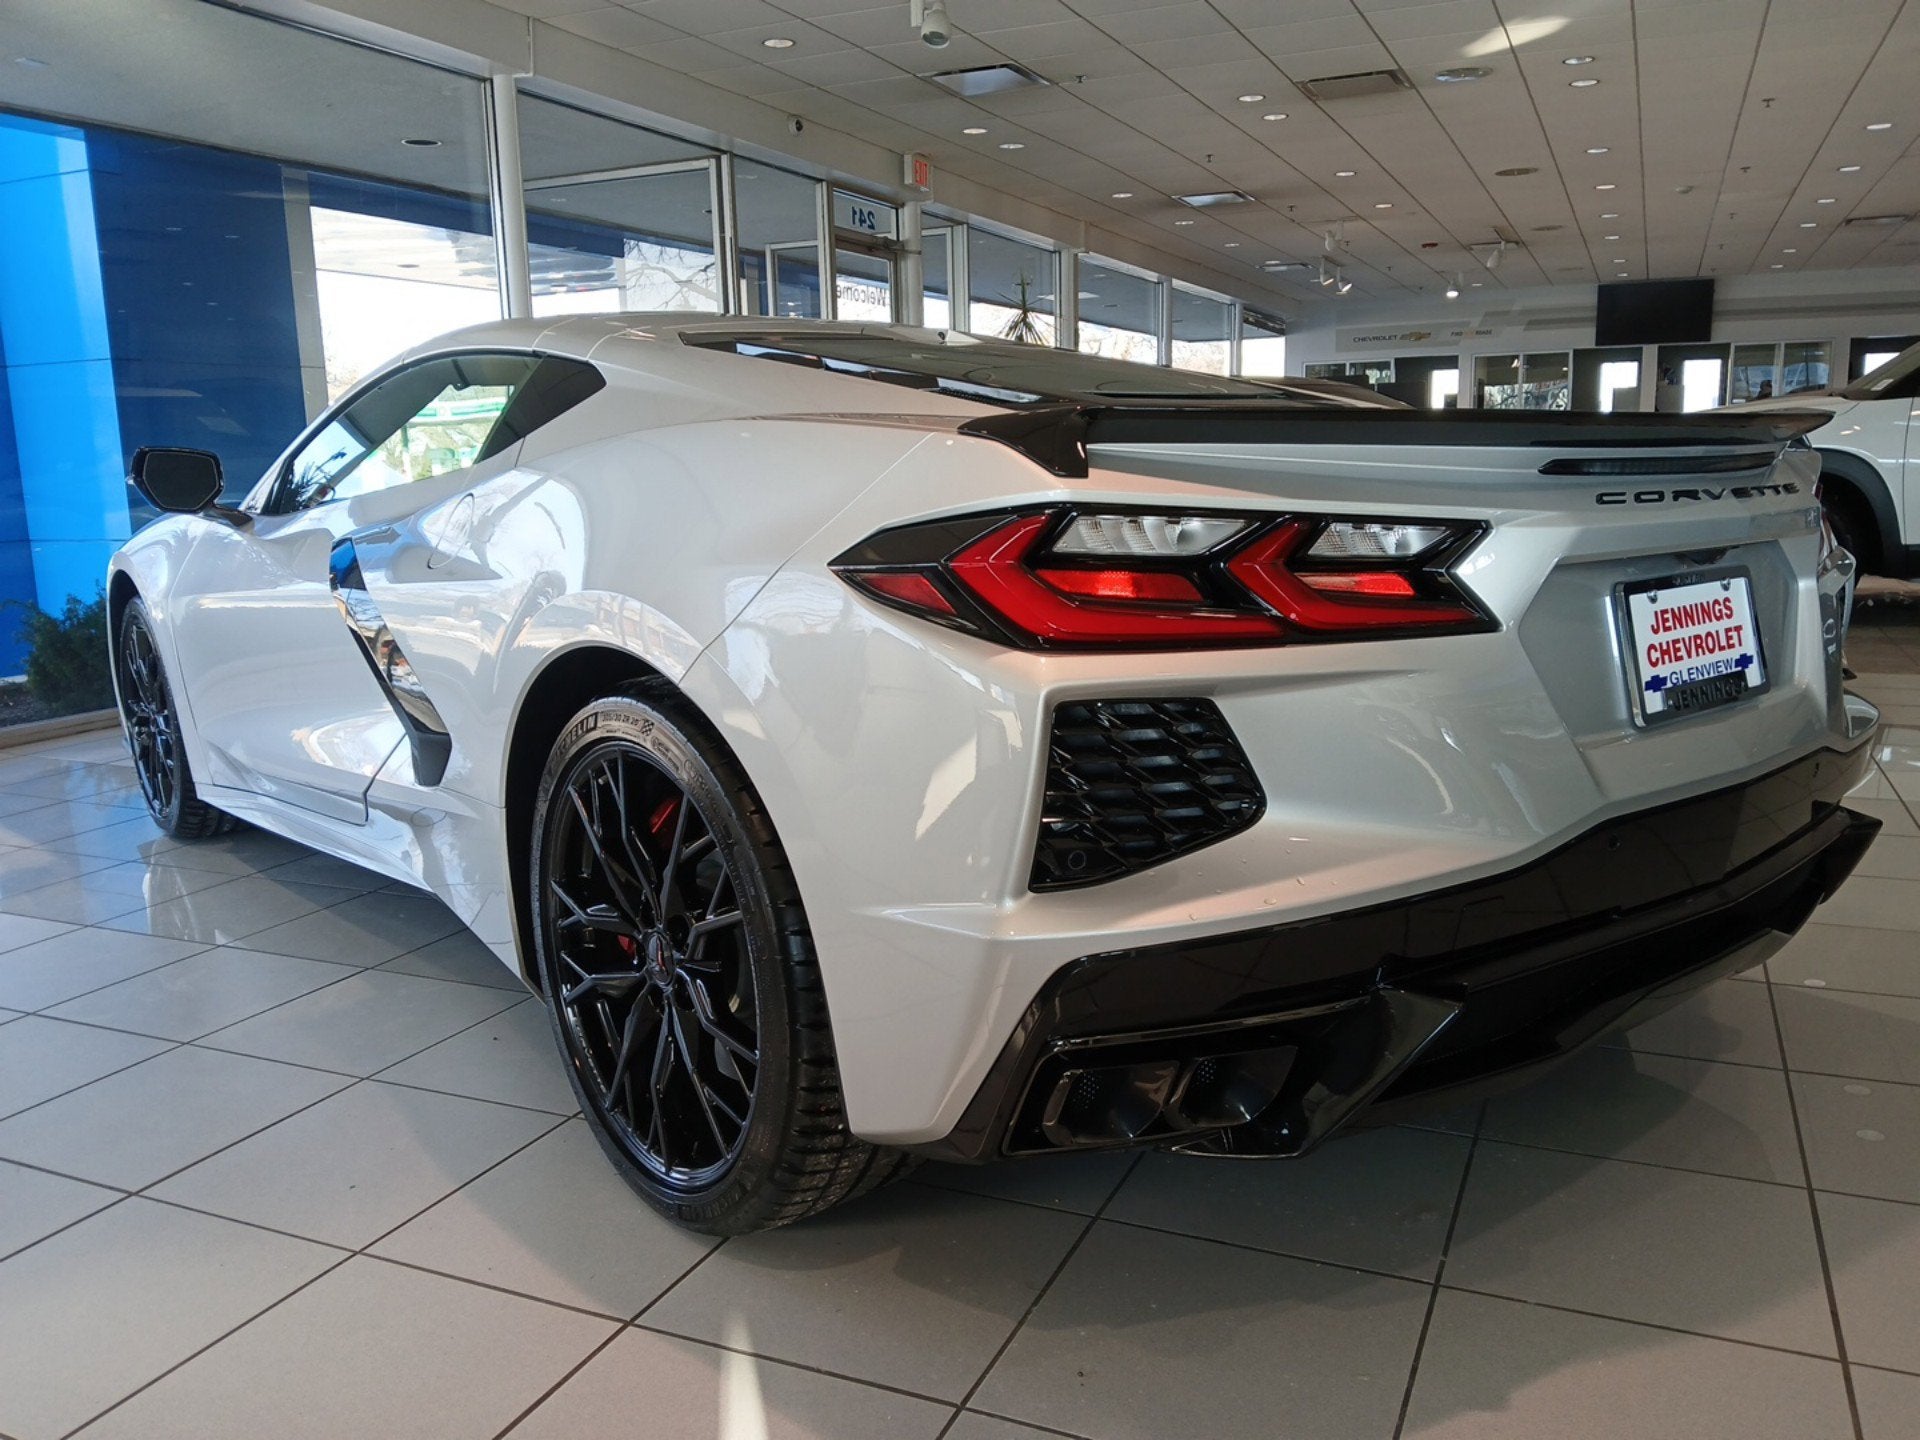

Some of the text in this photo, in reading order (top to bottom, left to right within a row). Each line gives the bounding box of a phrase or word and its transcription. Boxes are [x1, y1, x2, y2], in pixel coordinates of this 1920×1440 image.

[1353, 334, 1398, 343] CHEVROLET
[1596, 482, 1800, 505] CORVETTE
[1651, 597, 1733, 635] JENNINGS
[1647, 625, 1743, 668] CHEVROLET
[1669, 657, 1733, 686] GLENVIEW
